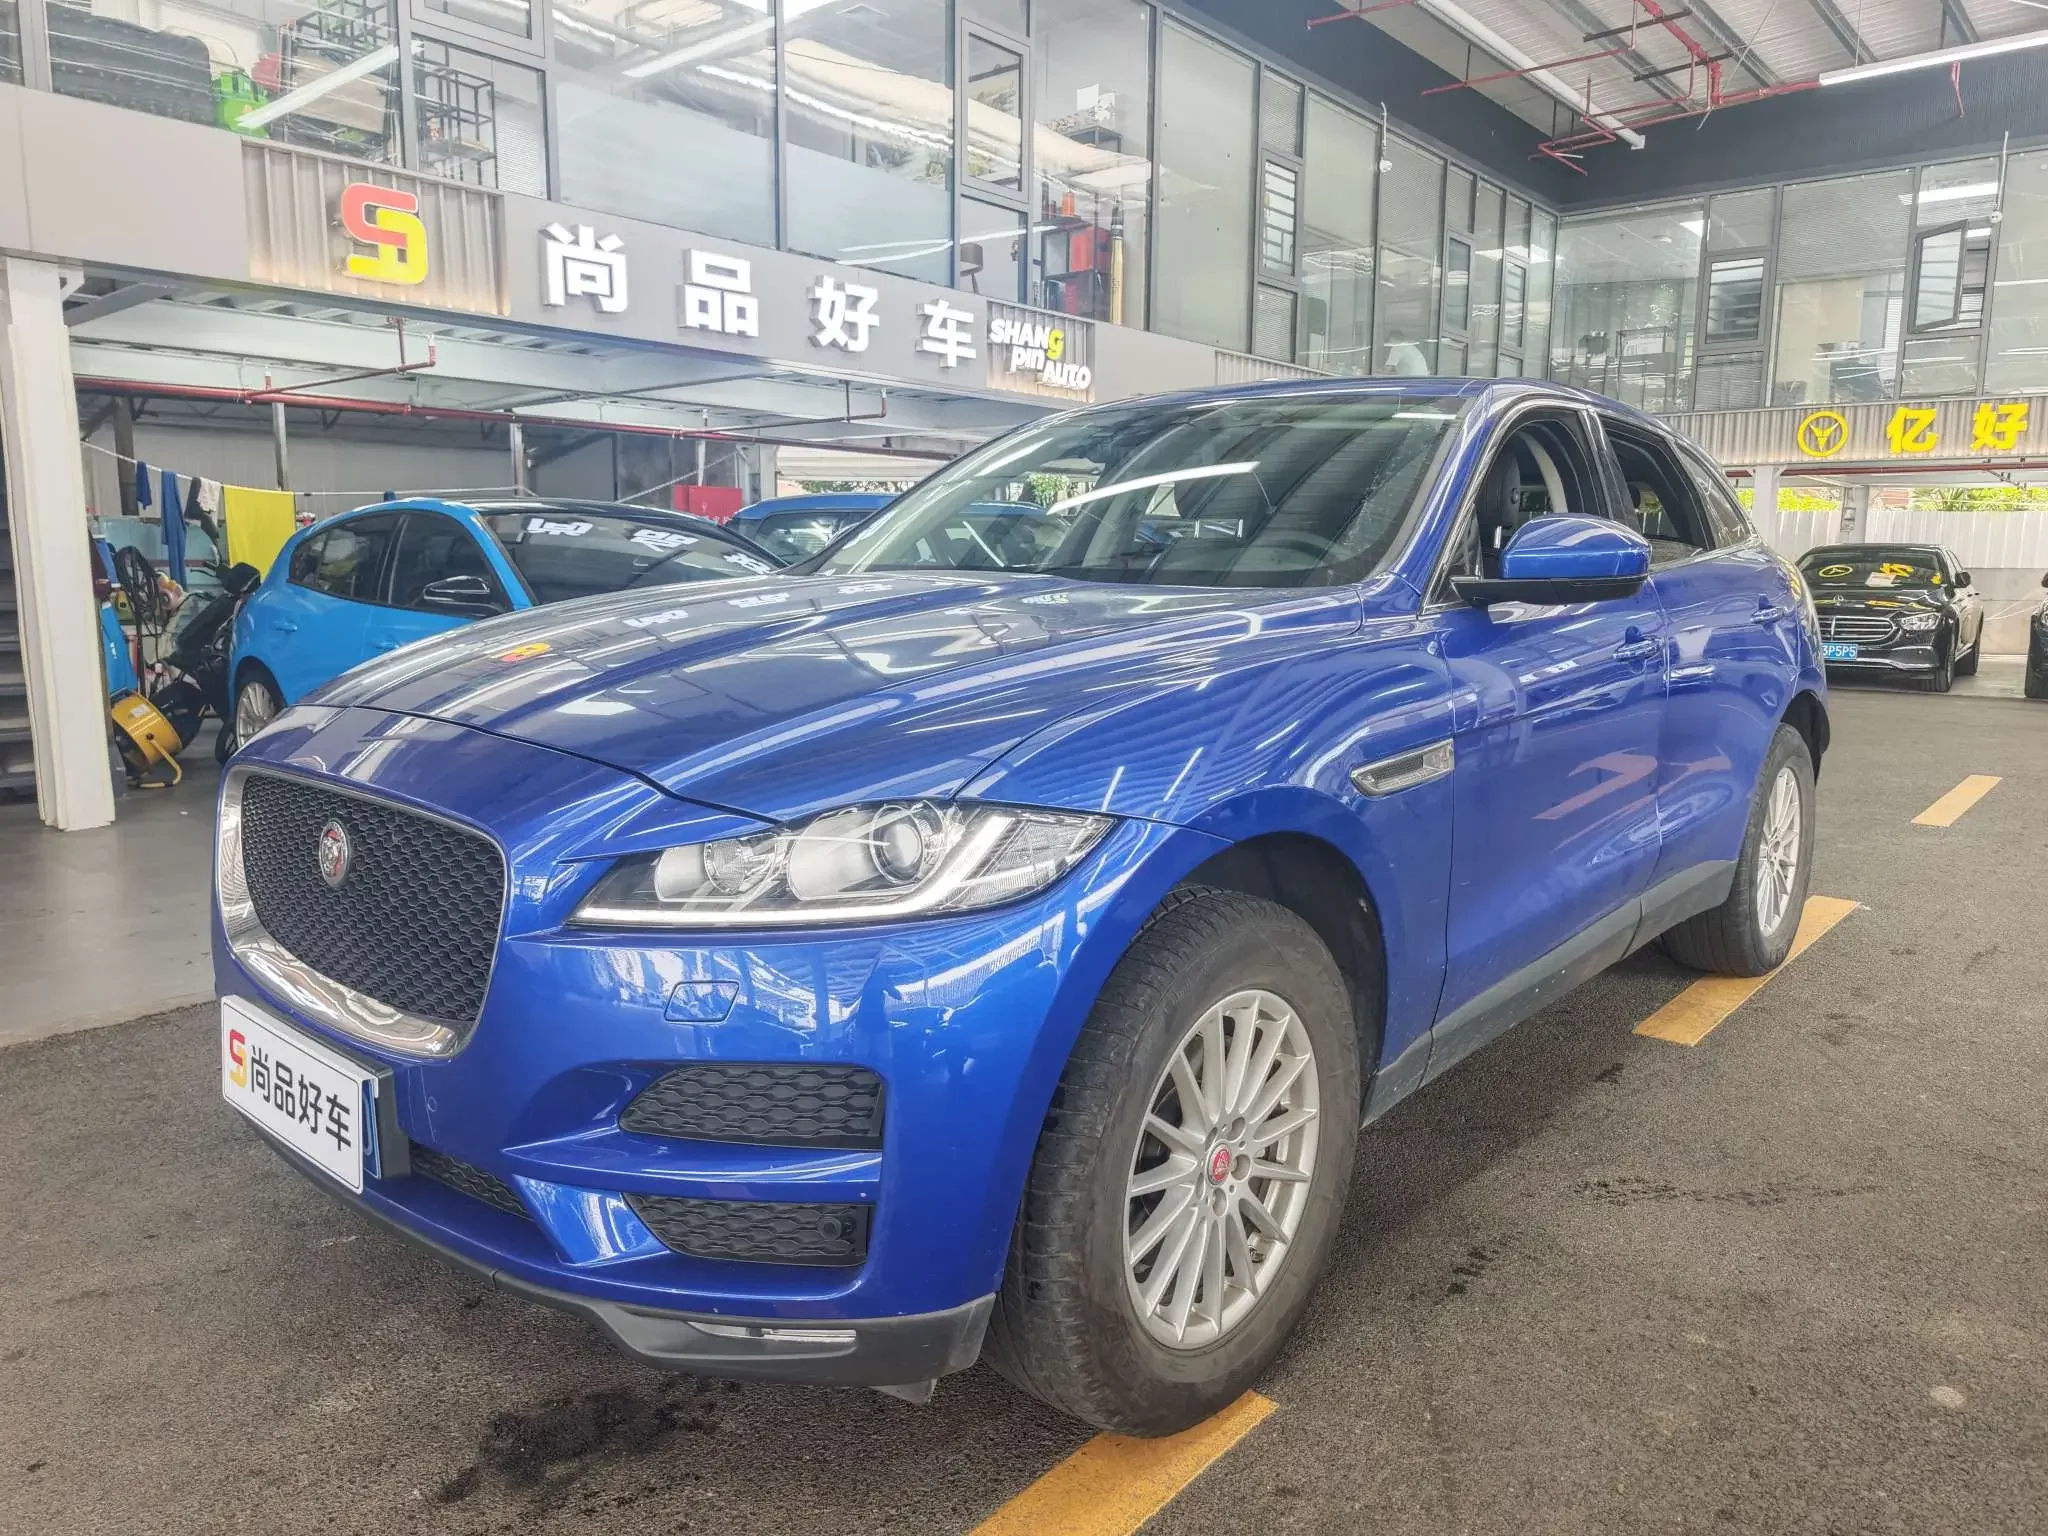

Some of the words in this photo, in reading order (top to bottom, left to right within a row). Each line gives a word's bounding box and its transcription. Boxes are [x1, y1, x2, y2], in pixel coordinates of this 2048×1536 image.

[541, 222, 977, 367] 尚品好车
[1042, 360, 1092, 391] AUTO
[1887, 403, 2029, 454] 亿好
[251, 1045, 352, 1152] 尚品好车
